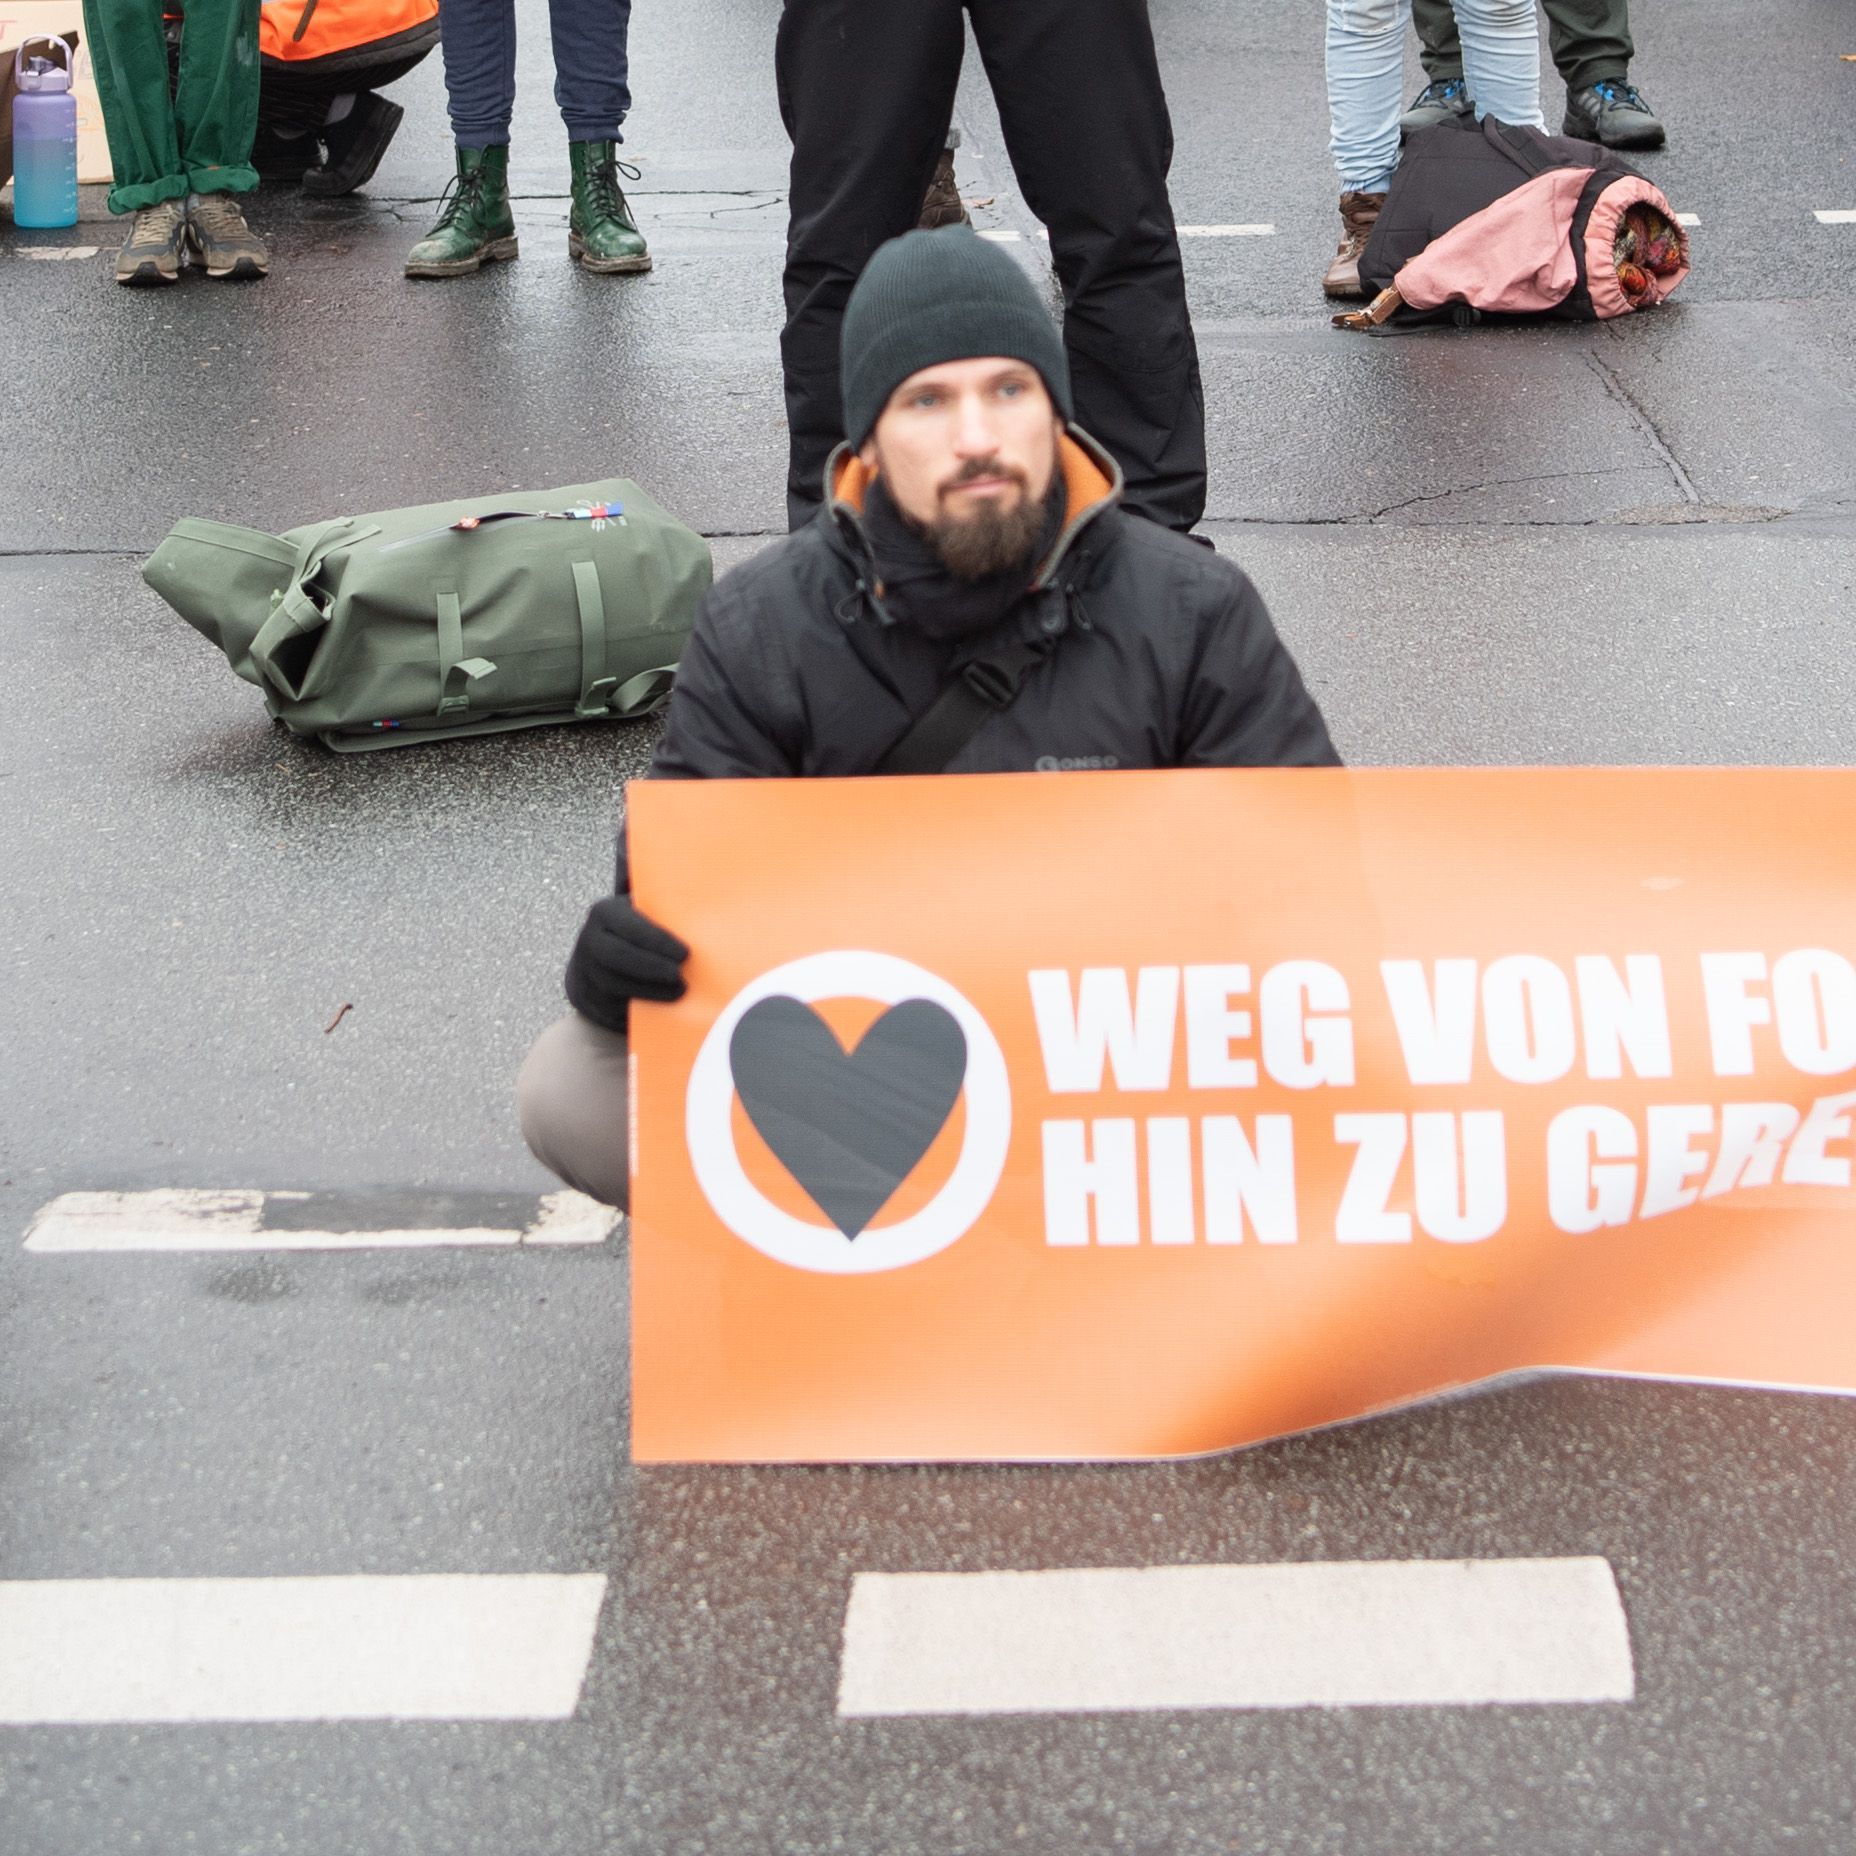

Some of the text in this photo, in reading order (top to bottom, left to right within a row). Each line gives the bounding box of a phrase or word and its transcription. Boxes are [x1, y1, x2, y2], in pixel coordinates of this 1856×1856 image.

[1028, 961, 1355, 1093] WEG
[1380, 953, 1670, 1085] VON
[1040, 1113, 1298, 1249] HIN
[1333, 1110, 1508, 1245] ZU
